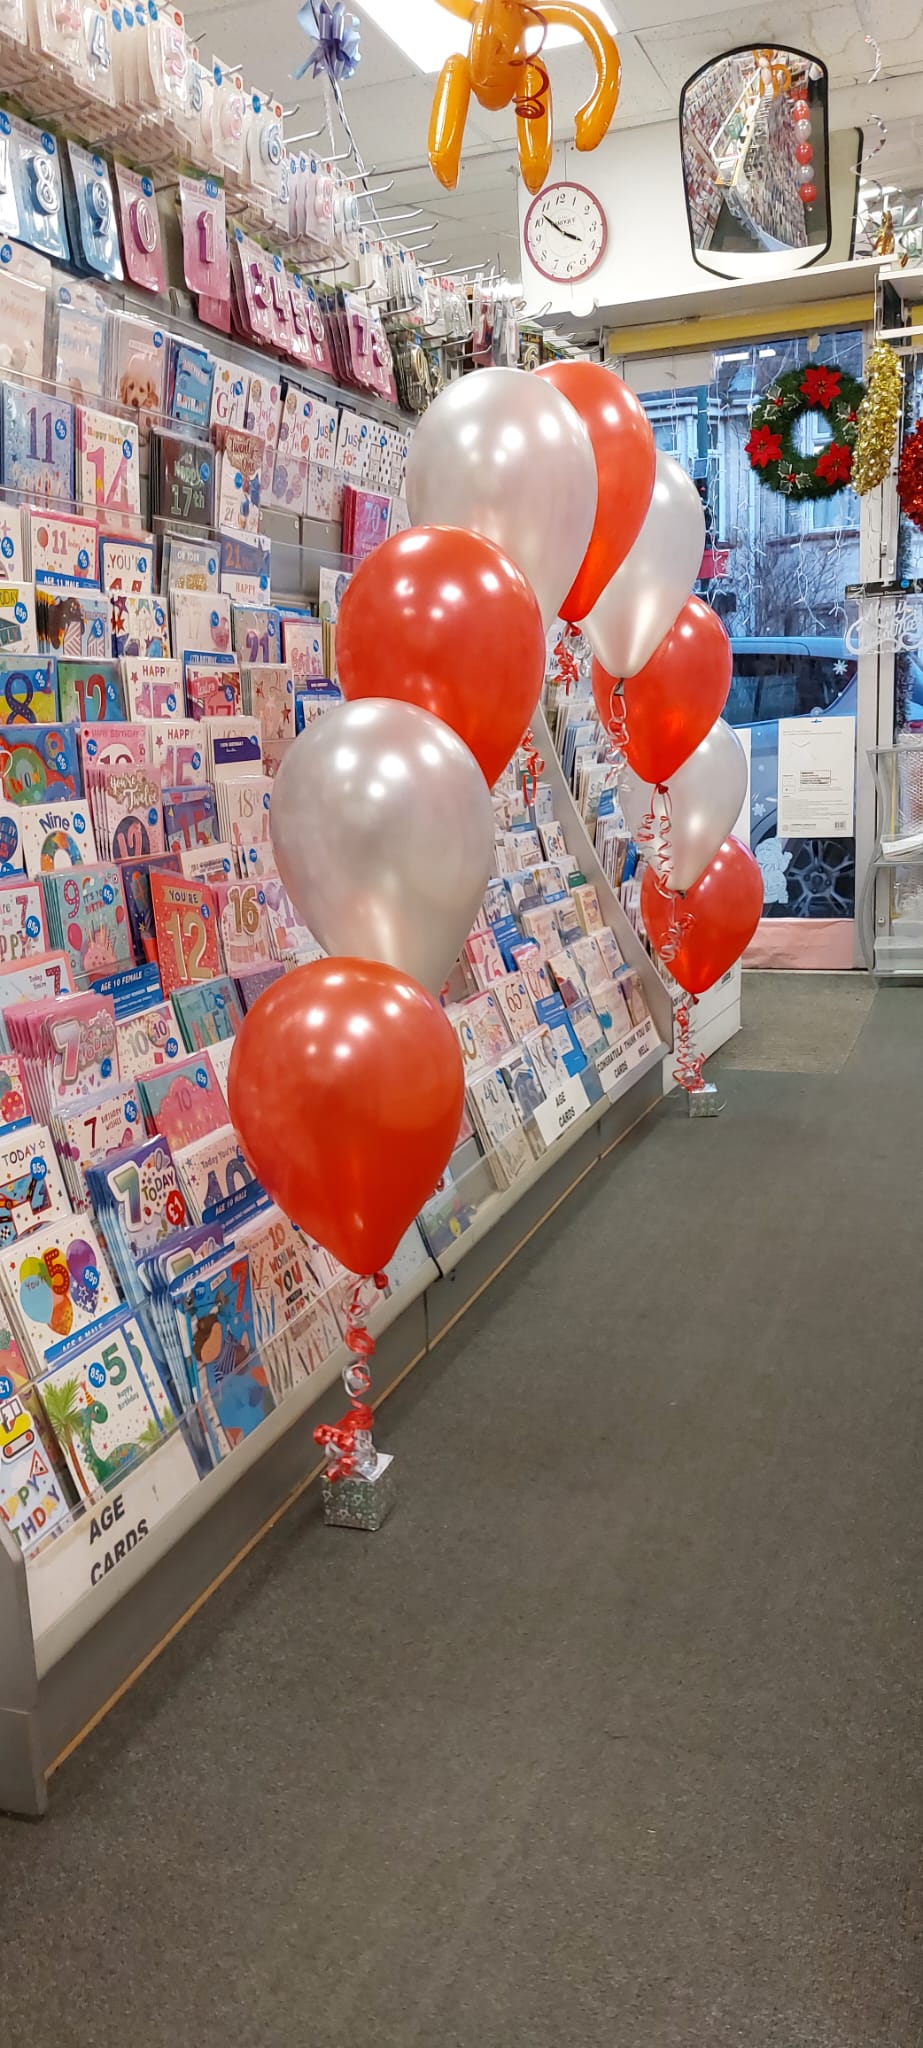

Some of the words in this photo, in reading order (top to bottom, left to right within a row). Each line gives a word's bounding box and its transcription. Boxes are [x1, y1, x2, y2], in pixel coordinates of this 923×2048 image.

[30, 154, 60, 216] 8
[542, 200, 550, 212] 11
[556, 193, 566, 206] 12
[572, 196, 576, 206] 1
[584, 204, 590, 215] 2
[535, 218, 544, 228] 10
[589, 221, 596, 232] 3
[541, 250, 547, 262] 8
[554, 259, 559, 270] 7
[567, 261, 576, 272] 6
[580, 253, 587, 265] 5
[26, 407, 55, 464] 11
[314, 418, 333, 442] Just
[341, 427, 362, 451] Just
[86, 446, 135, 529] 14
[52, 530, 68, 554] 11
[224, 542, 242, 569] 21
[65, 580, 79, 588] MALE
[235, 582, 256, 596] HAPPY
[246, 631, 270, 662] 21
[142, 665, 170, 677] HAPPY
[5, 672, 37, 724] 8
[74, 673, 106, 721] 12
[168, 728, 194, 741] HAPPY
[38, 811, 70, 834] Nine
[74, 818, 85, 830] 85p
[117, 822, 142, 858] 12
[63, 879, 80, 919] 9
[168, 890, 198, 904] YOU'RE
[16, 895, 28, 929] 7
[228, 886, 260, 936] 16
[27, 920, 38, 934] 85p
[165, 910, 215, 980] 12
[45, 965, 61, 997] 7
[101, 981, 111, 992] AGE
[114, 979, 120, 988] 10
[122, 971, 142, 985] FEMALE
[505, 984, 522, 1013] 65
[153, 1020, 167, 1039] 10
[624, 1034, 637, 1050] THANK
[636, 1028, 645, 1038] YOU
[53, 1018, 82, 1080] 7
[638, 1043, 650, 1058] WELL
[614, 1060, 628, 1078] CARDS
[556, 1091, 566, 1107] AGE
[559, 1106, 576, 1128] CARDS
[84, 1116, 97, 1149] 7
[1, 1142, 36, 1167] TODAY
[32, 1162, 46, 1176] 85p
[113, 1166, 142, 1224] 7
[141, 1171, 175, 1202] TODAY
[168, 1200, 183, 1223] £1
[216, 1204, 225, 1216] AGE
[234, 1190, 247, 1204] MALE
[268, 1223, 286, 1251] 10
[44, 1248, 70, 1295] 5
[84, 1271, 98, 1286] 85p
[274, 1260, 304, 1298] YOU
[231, 1260, 247, 1312] 7
[284, 1292, 310, 1322] HAPPY
[85, 1322, 104, 1338] MALE
[102, 1342, 127, 1386] 5
[0, 1380, 10, 1394] £1
[90, 1368, 104, 1384] 85p
[90, 1494, 126, 1546] AGE
[90, 1518, 150, 1586] CARDS
